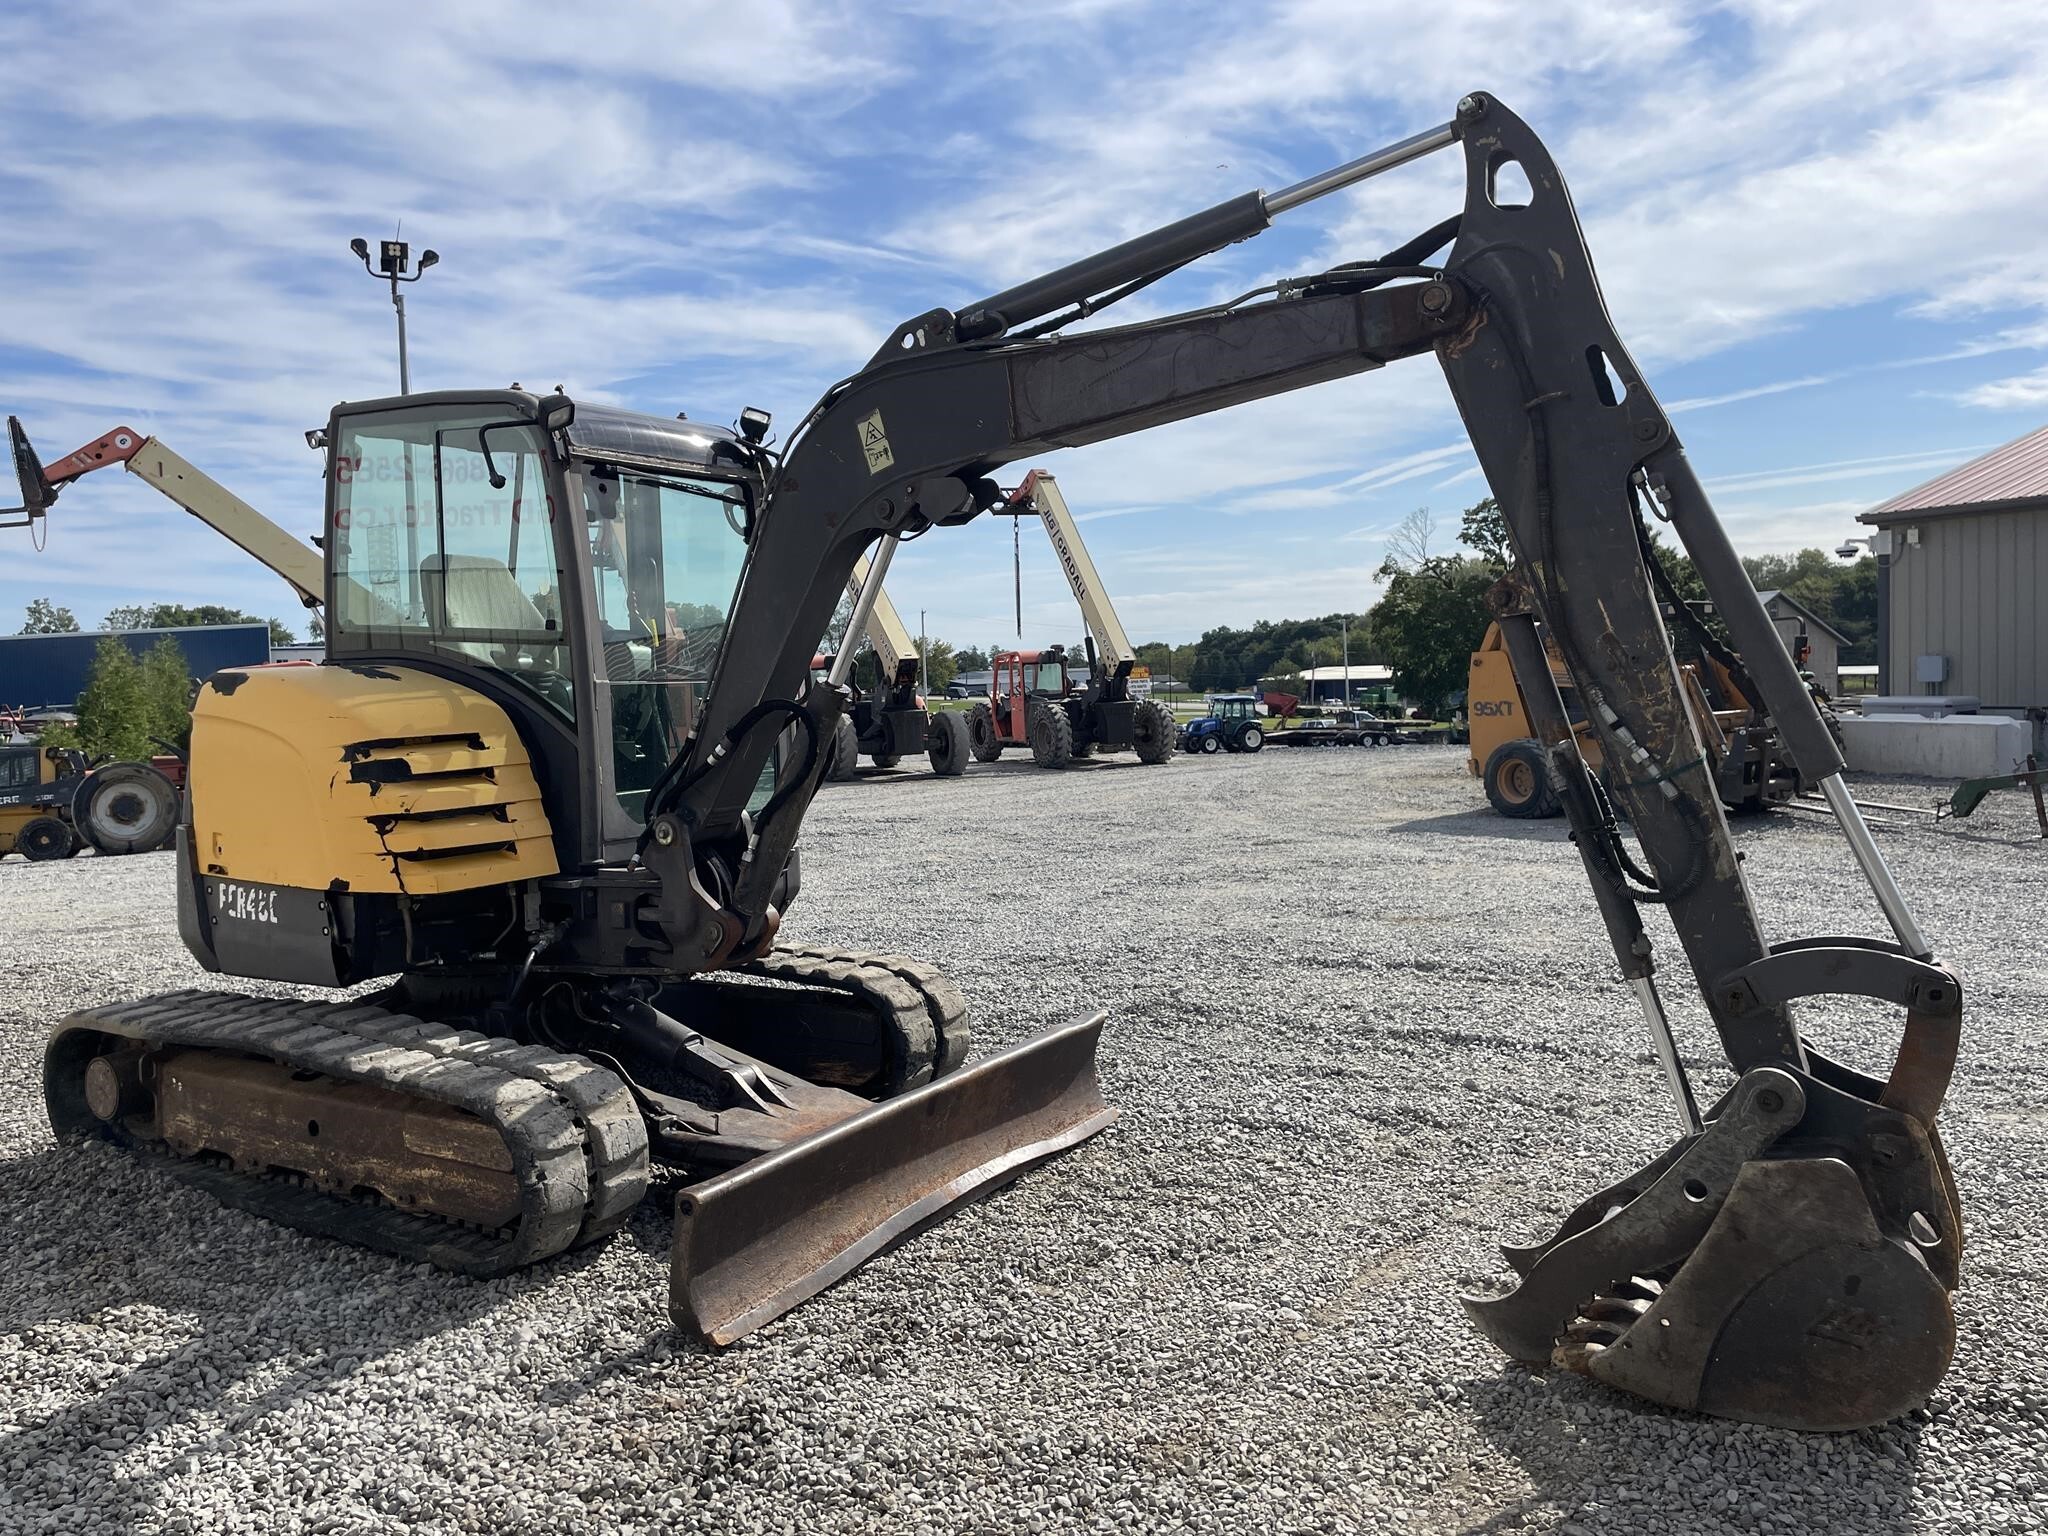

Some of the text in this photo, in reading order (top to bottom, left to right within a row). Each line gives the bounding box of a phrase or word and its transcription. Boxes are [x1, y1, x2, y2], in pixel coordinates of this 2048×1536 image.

[1043, 509, 1086, 601] JLG GRADALL
[1473, 701, 1514, 717] 95XT
